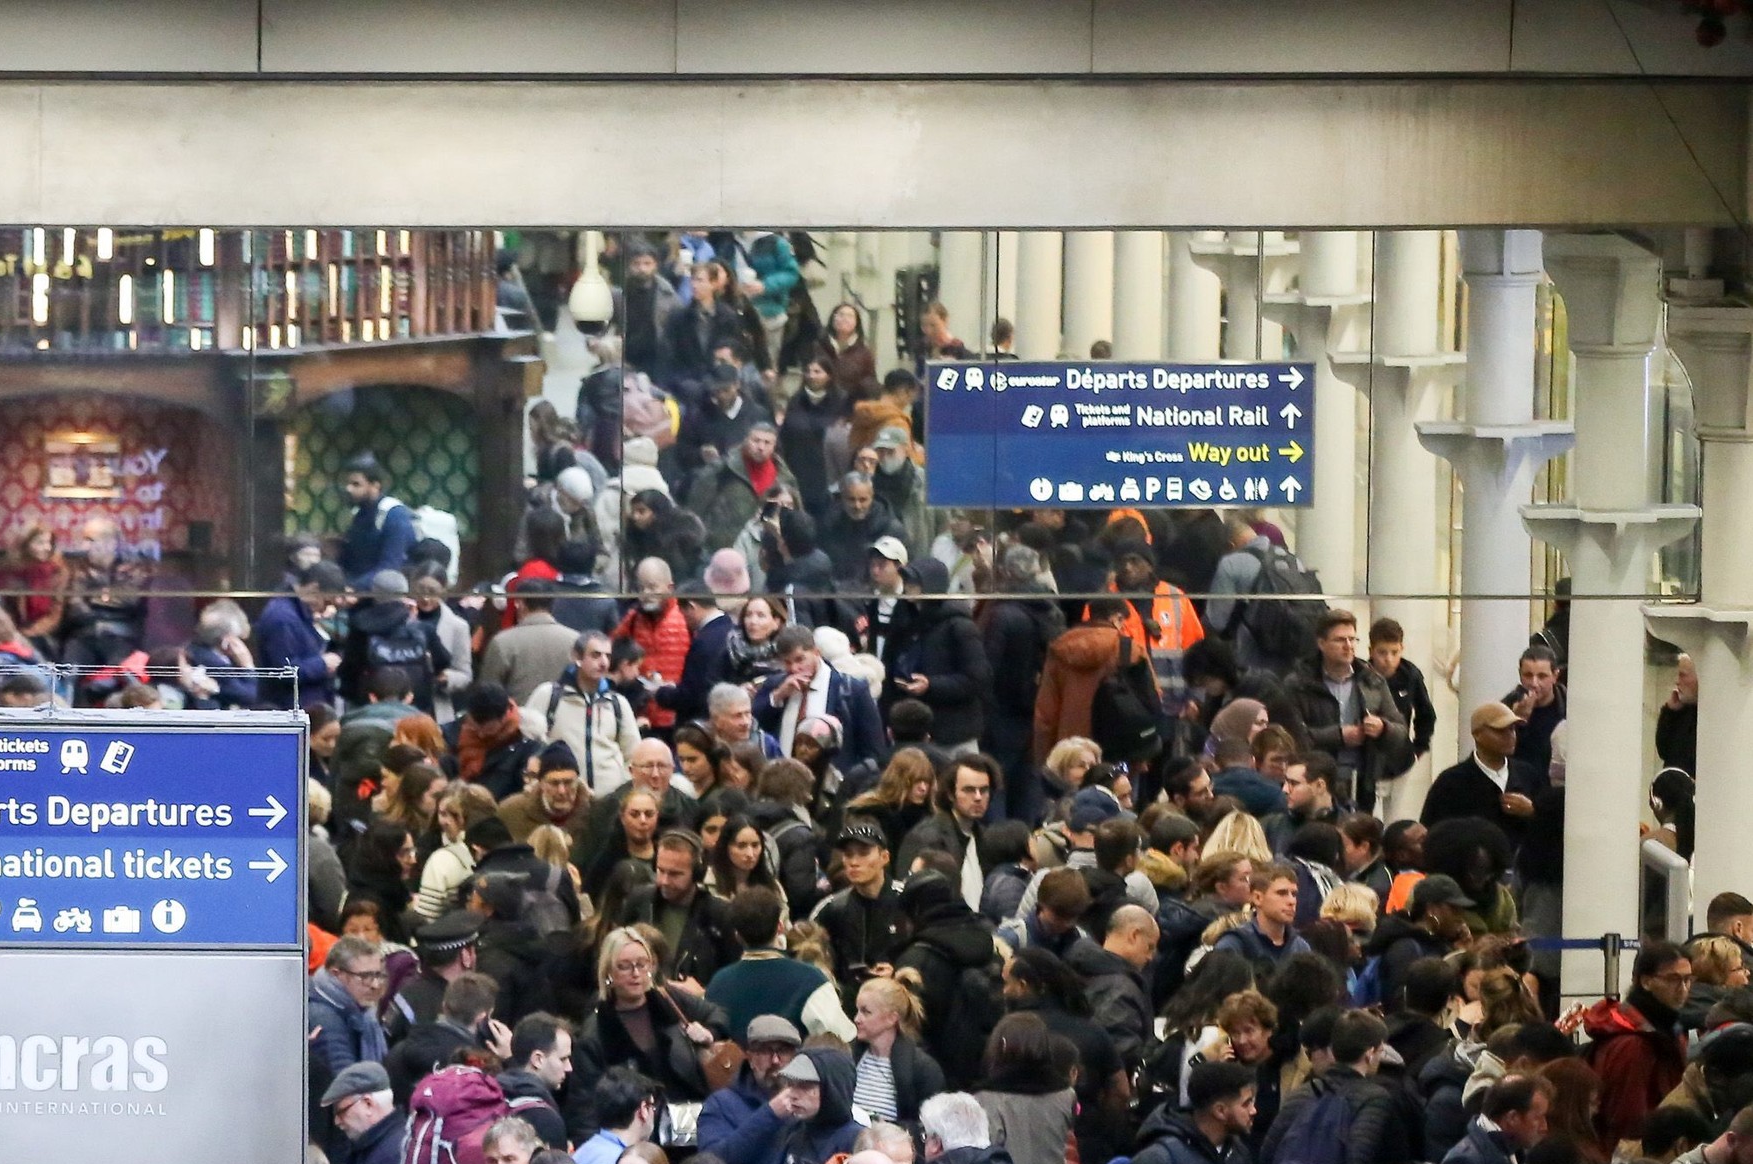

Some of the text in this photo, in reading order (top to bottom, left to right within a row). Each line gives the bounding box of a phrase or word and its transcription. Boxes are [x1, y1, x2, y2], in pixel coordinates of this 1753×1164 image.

[1066, 367, 1148, 394] Départs
[1153, 369, 1270, 394] Departures
[1074, 403, 1131, 415] Tickets and
[1136, 405, 1270, 427] National Rail
[1082, 416, 1131, 428] platforms
[1122, 450, 1153, 464] King's
[1154, 450, 1184, 463] Cross
[1188, 442, 1271, 467] Way out
[48, 796, 232, 832] Departures
[123, 849, 232, 879] tickets
